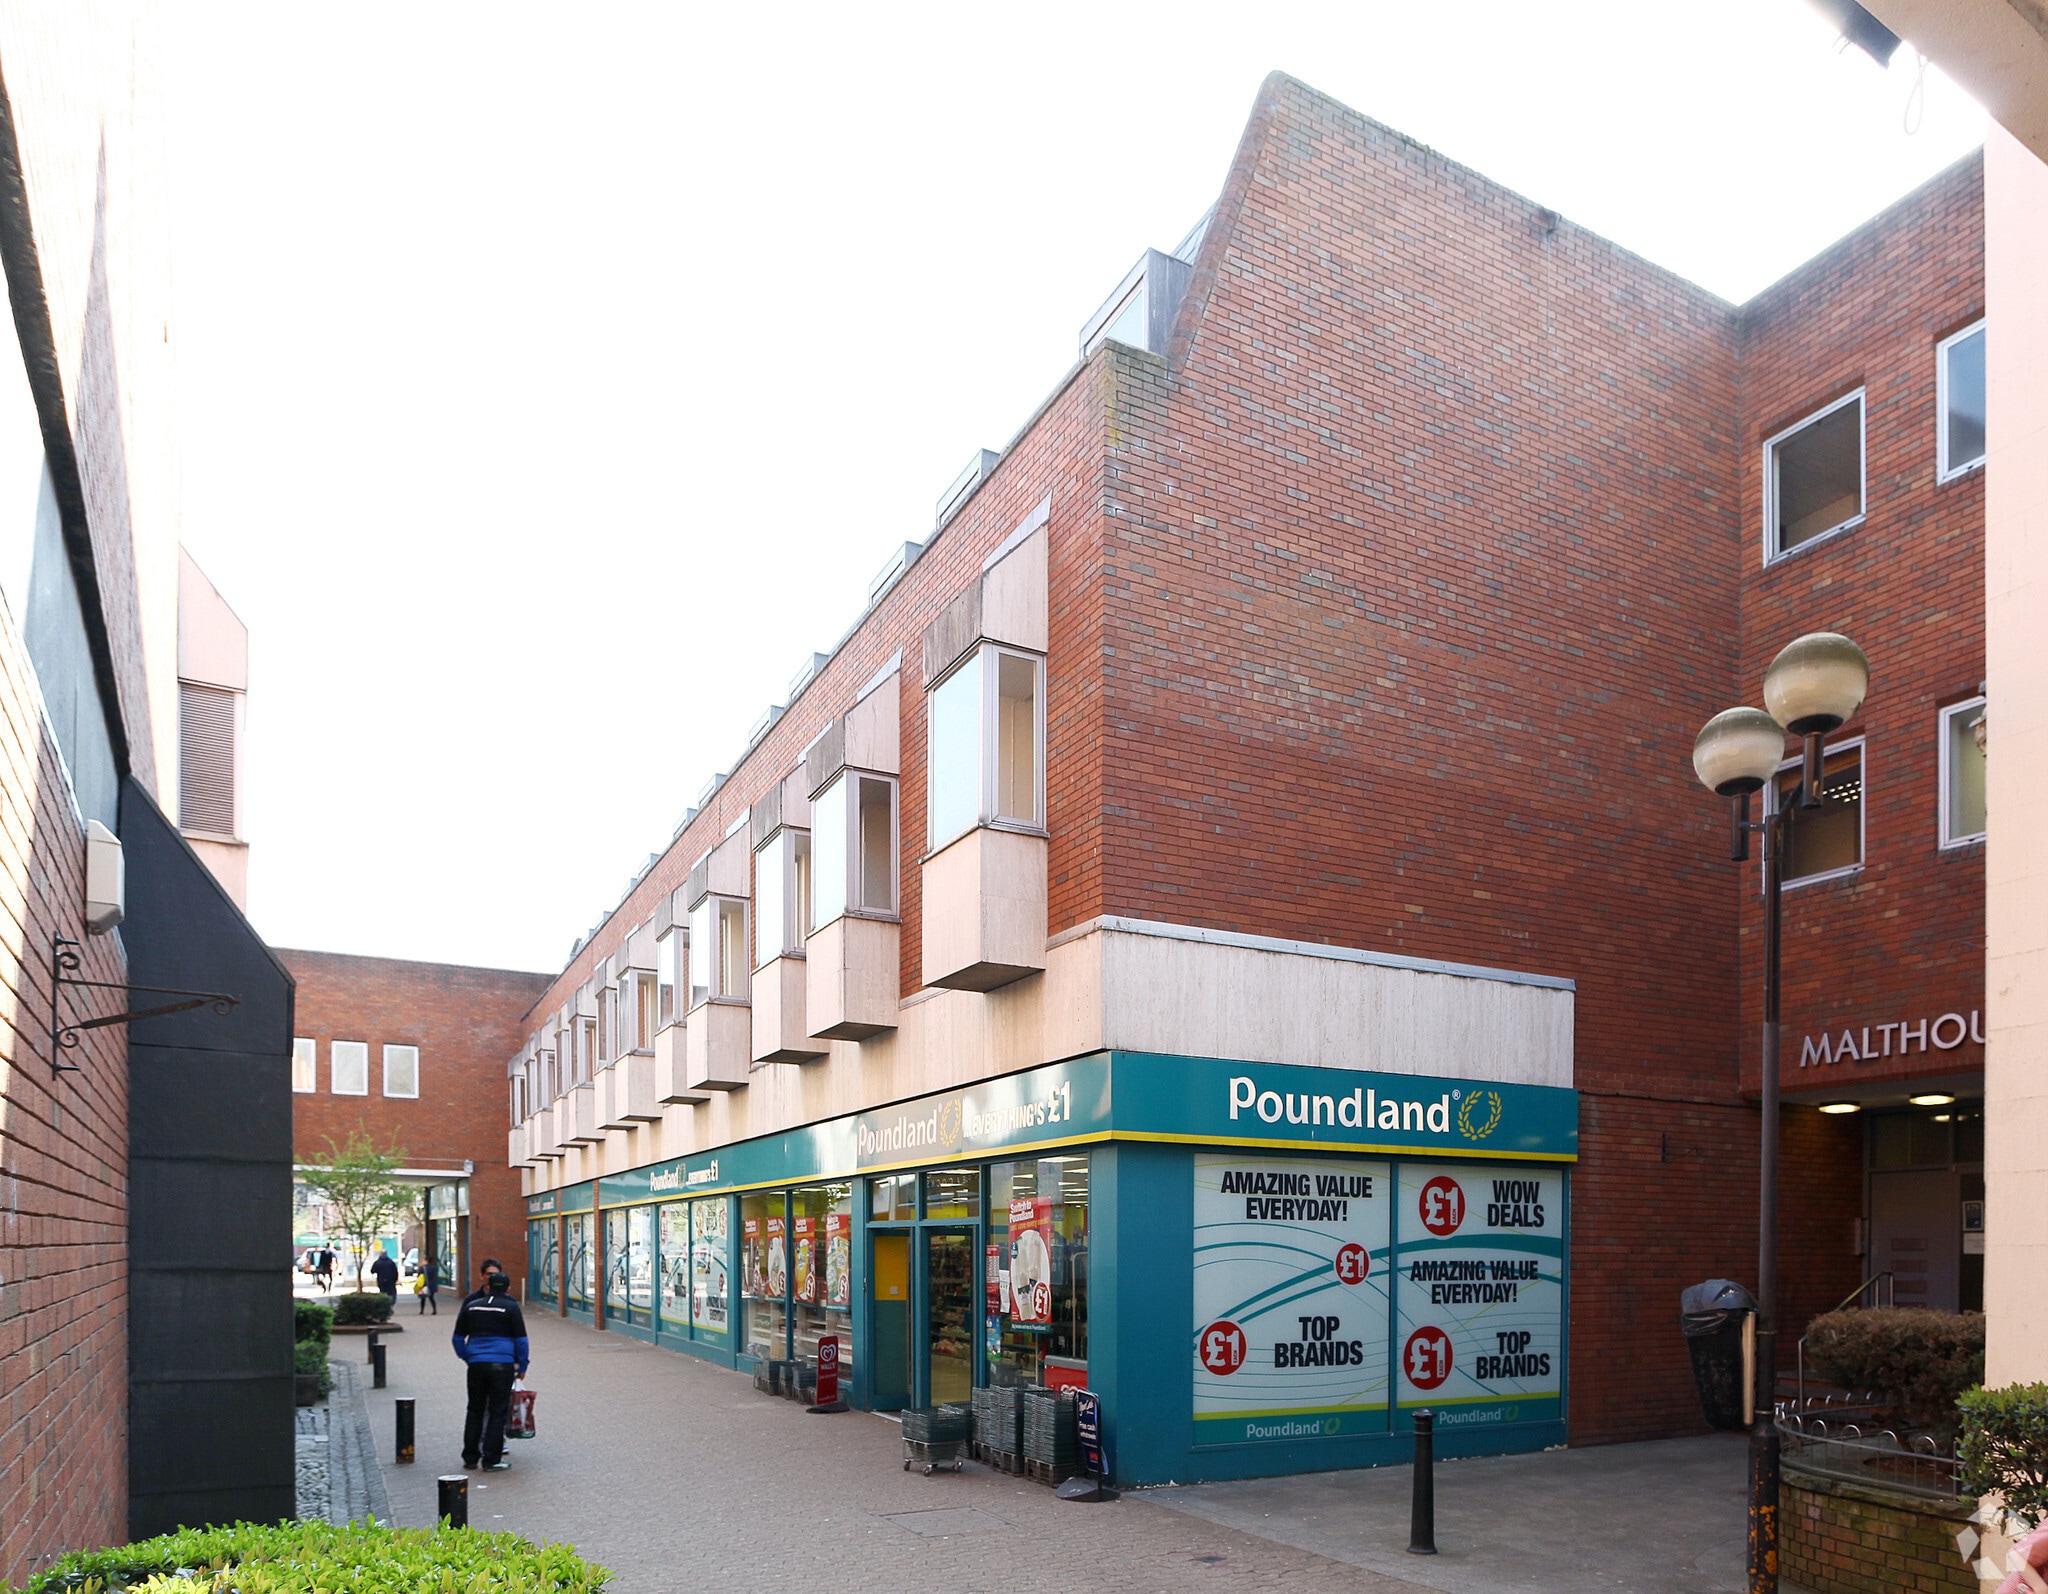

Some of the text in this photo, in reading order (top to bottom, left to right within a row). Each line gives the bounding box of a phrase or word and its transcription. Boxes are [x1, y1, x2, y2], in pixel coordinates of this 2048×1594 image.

[1047, 1081, 1071, 1123] £1
[1221, 1171, 1372, 1198] AMAZING VALUE
[1492, 1180, 1540, 1204] WOW
[1246, 1197, 1347, 1221] EVERYDAY!
[1425, 1186, 1459, 1226] £1
[1487, 1203, 1544, 1228] DEALS
[1340, 1250, 1365, 1279] £1
[1410, 1260, 1538, 1281] AMAZING VALUE
[1035, 1288, 1048, 1315] £1
[1431, 1283, 1517, 1304] EVERYDAY!
[1299, 1316, 1340, 1341] TOP
[1206, 1330, 1240, 1367] £1
[1274, 1340, 1363, 1368] BRANDS
[1496, 1331, 1531, 1354] TOP
[1410, 1337, 1446, 1380] £1
[1476, 1353, 1550, 1379] BRANDS
[1439, 1408, 1501, 1424] Poundland
[1247, 1420, 1320, 1438] Poundland
